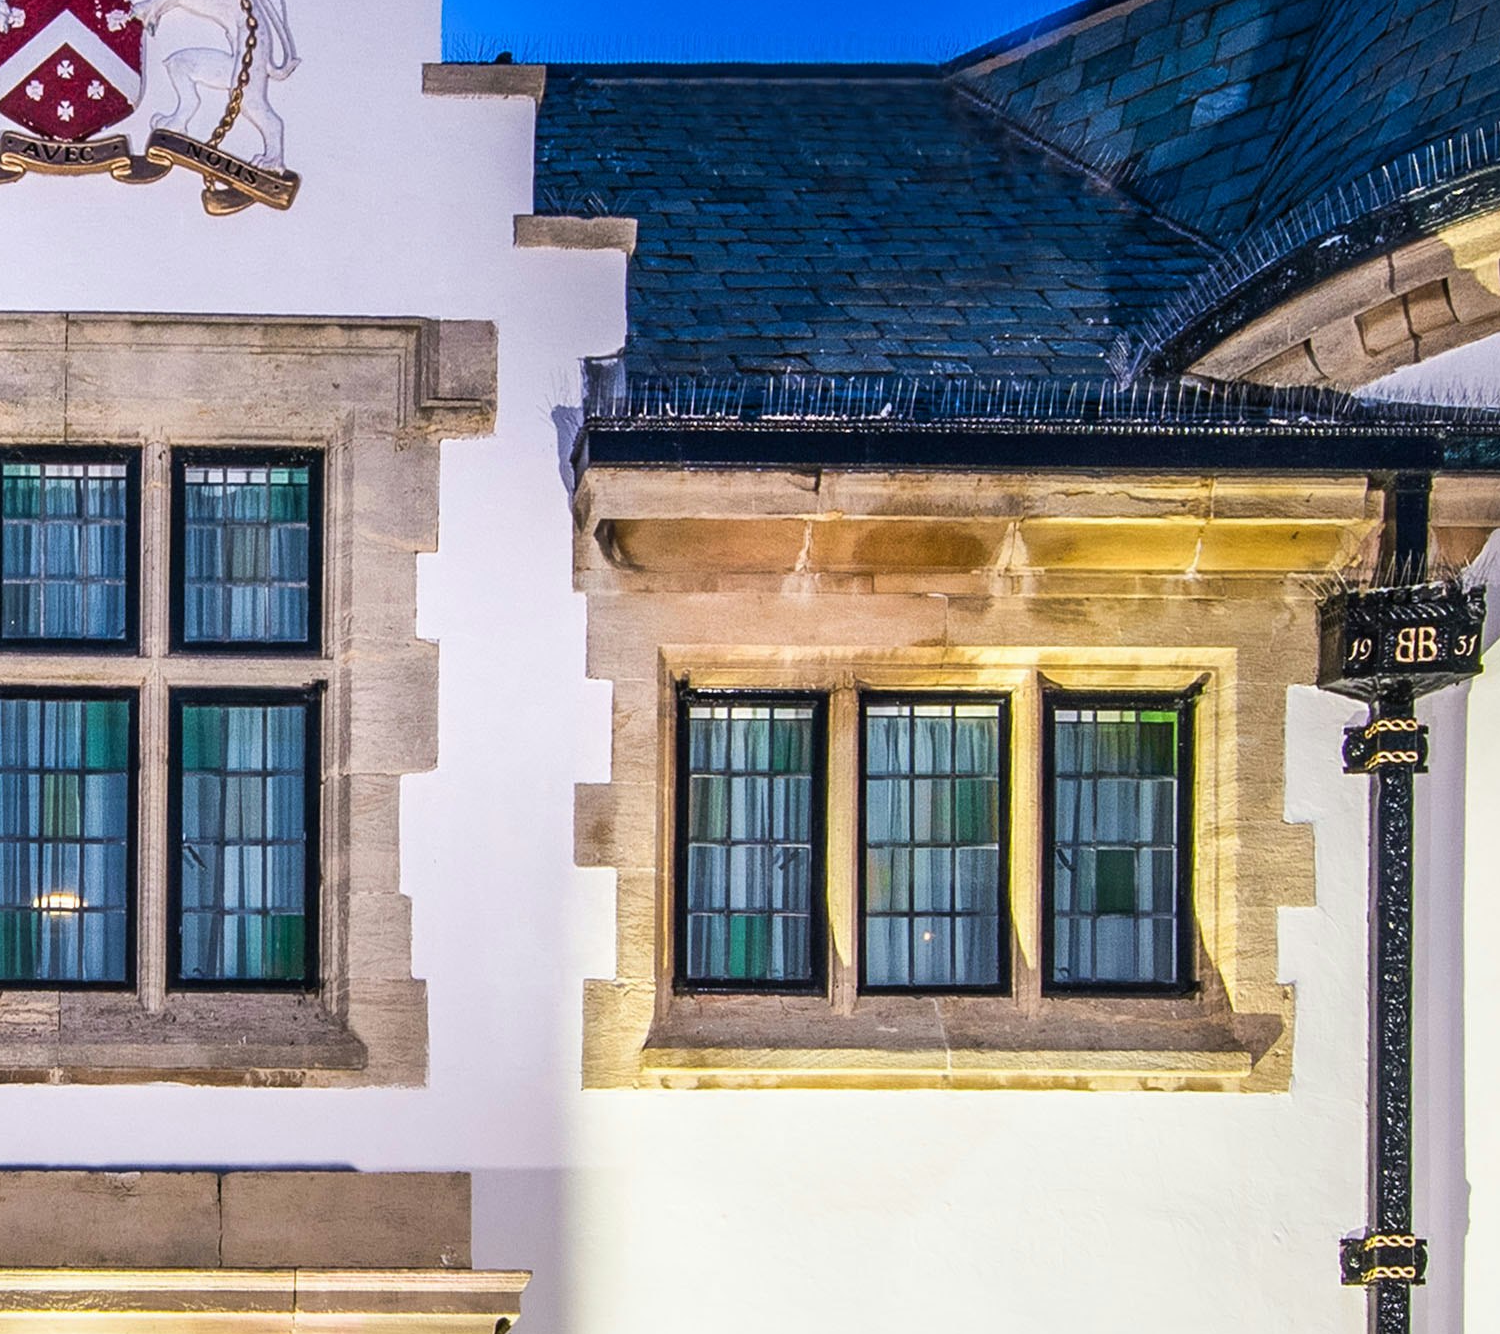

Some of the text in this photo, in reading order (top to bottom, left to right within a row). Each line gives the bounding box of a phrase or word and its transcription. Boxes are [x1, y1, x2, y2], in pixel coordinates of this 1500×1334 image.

[21, 143, 96, 164] AVEC
[186, 141, 259, 186] NOUS
[1347, 638, 1373, 661] 19
[1454, 634, 1478, 657] 31
